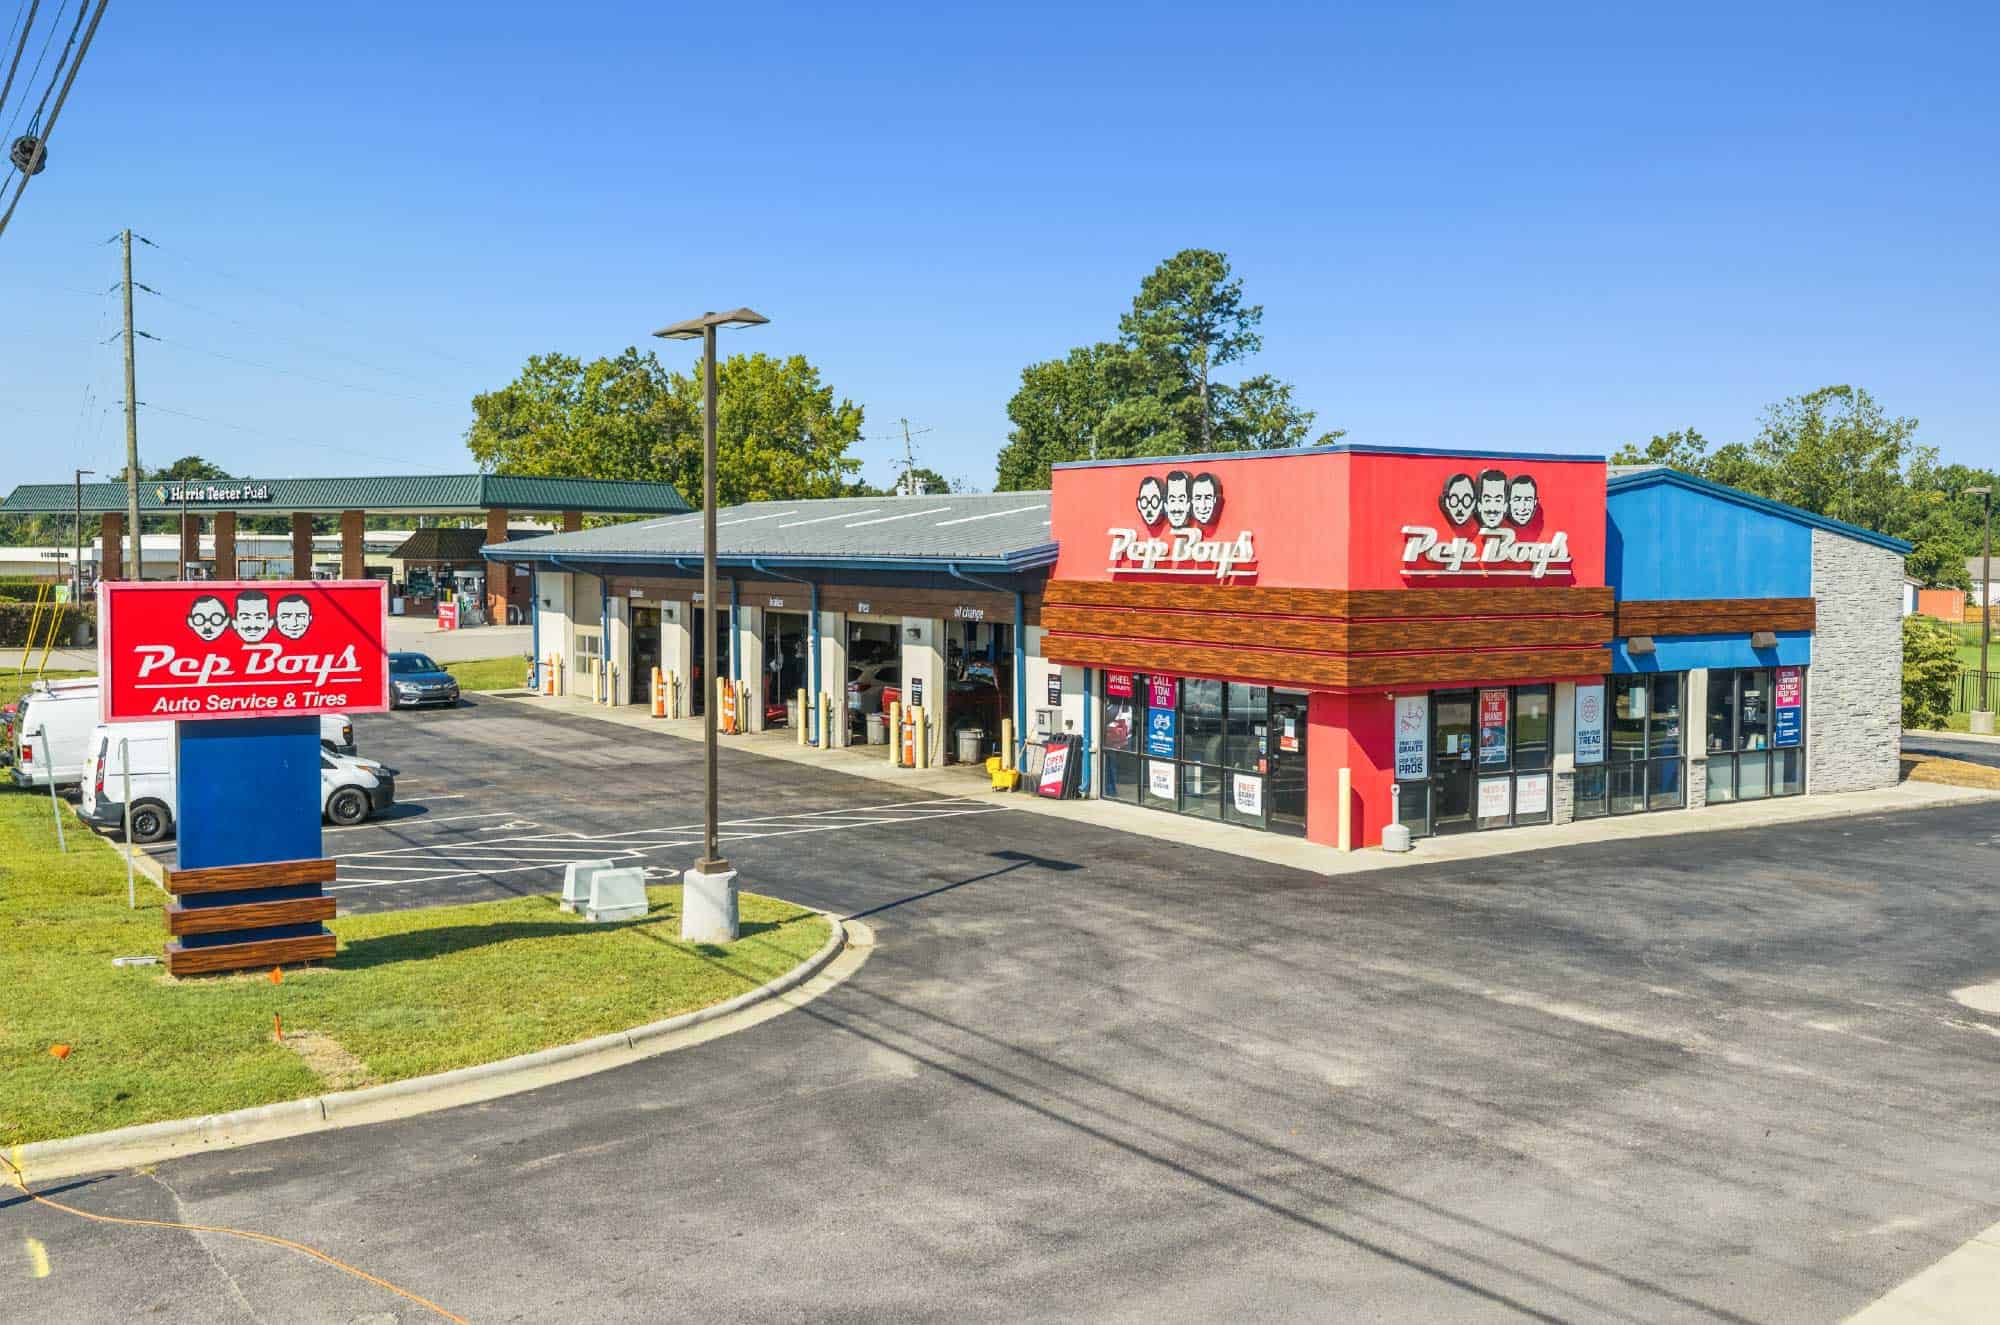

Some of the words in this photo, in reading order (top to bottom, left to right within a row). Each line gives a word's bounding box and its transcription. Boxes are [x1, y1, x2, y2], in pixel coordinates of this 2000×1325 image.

[171, 486, 205, 500] Harris
[207, 486, 241, 500] Teeter
[243, 485, 268, 499] Fuel
[1106, 528, 1171, 569] Pep
[1170, 527, 1258, 579] Boys
[1401, 525, 1480, 572] Pep
[1479, 527, 1571, 578] Boys
[962, 607, 984, 621] change
[133, 643, 236, 686] Pep
[241, 642, 363, 687] Boys
[1109, 674, 1130, 684] WHEEL
[152, 696, 201, 712] Auto
[206, 693, 278, 711] Service
[283, 694, 297, 708] &
[302, 691, 347, 707] Tires
[1579, 736, 1600, 744] TREAD
[1046, 754, 1064, 768] OPEN
[1399, 763, 1423, 774] PROS
